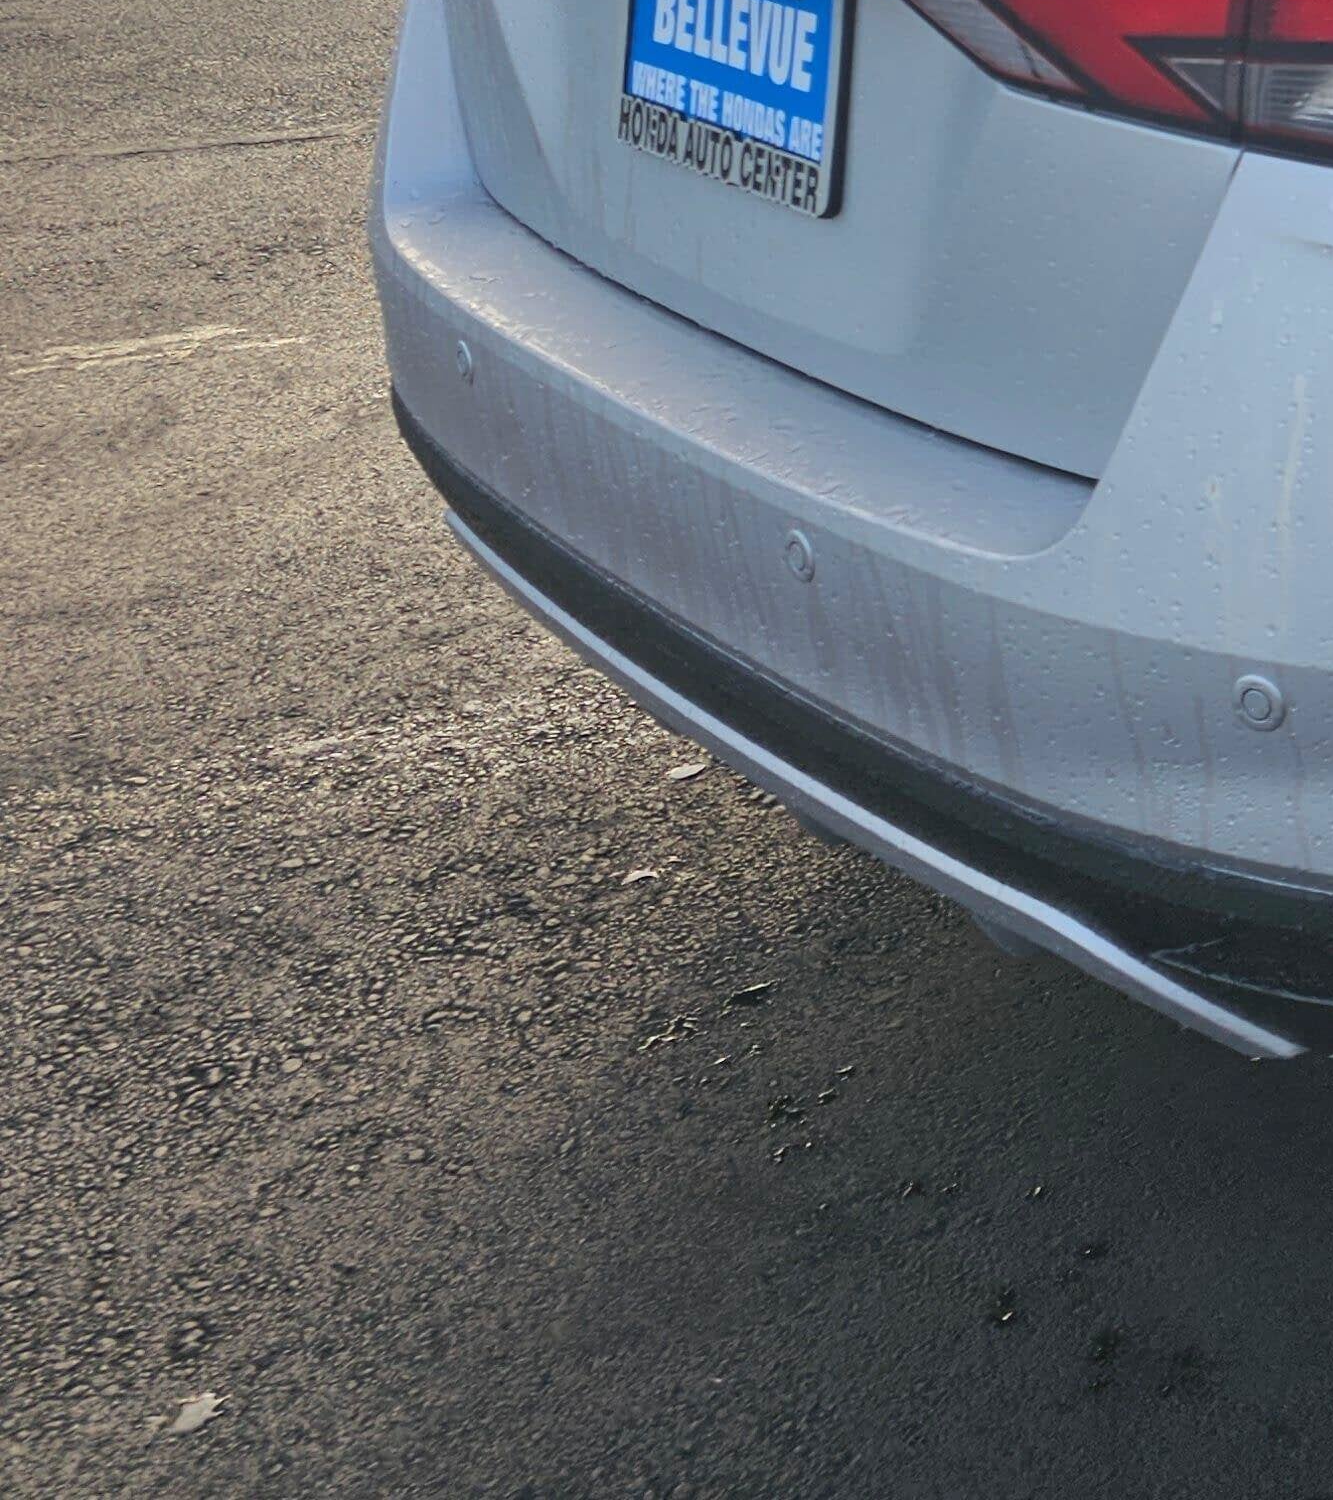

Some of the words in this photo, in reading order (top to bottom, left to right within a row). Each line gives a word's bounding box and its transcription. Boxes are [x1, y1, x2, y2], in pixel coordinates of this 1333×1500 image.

[618, 99, 679, 160] HONDA
[683, 123, 733, 180] AUTO
[740, 146, 820, 213] CENTER
[631, 60, 687, 111] WHERE
[690, 79, 719, 122] THE
[722, 90, 785, 149] HONDAS
[788, 116, 823, 162] ARE
